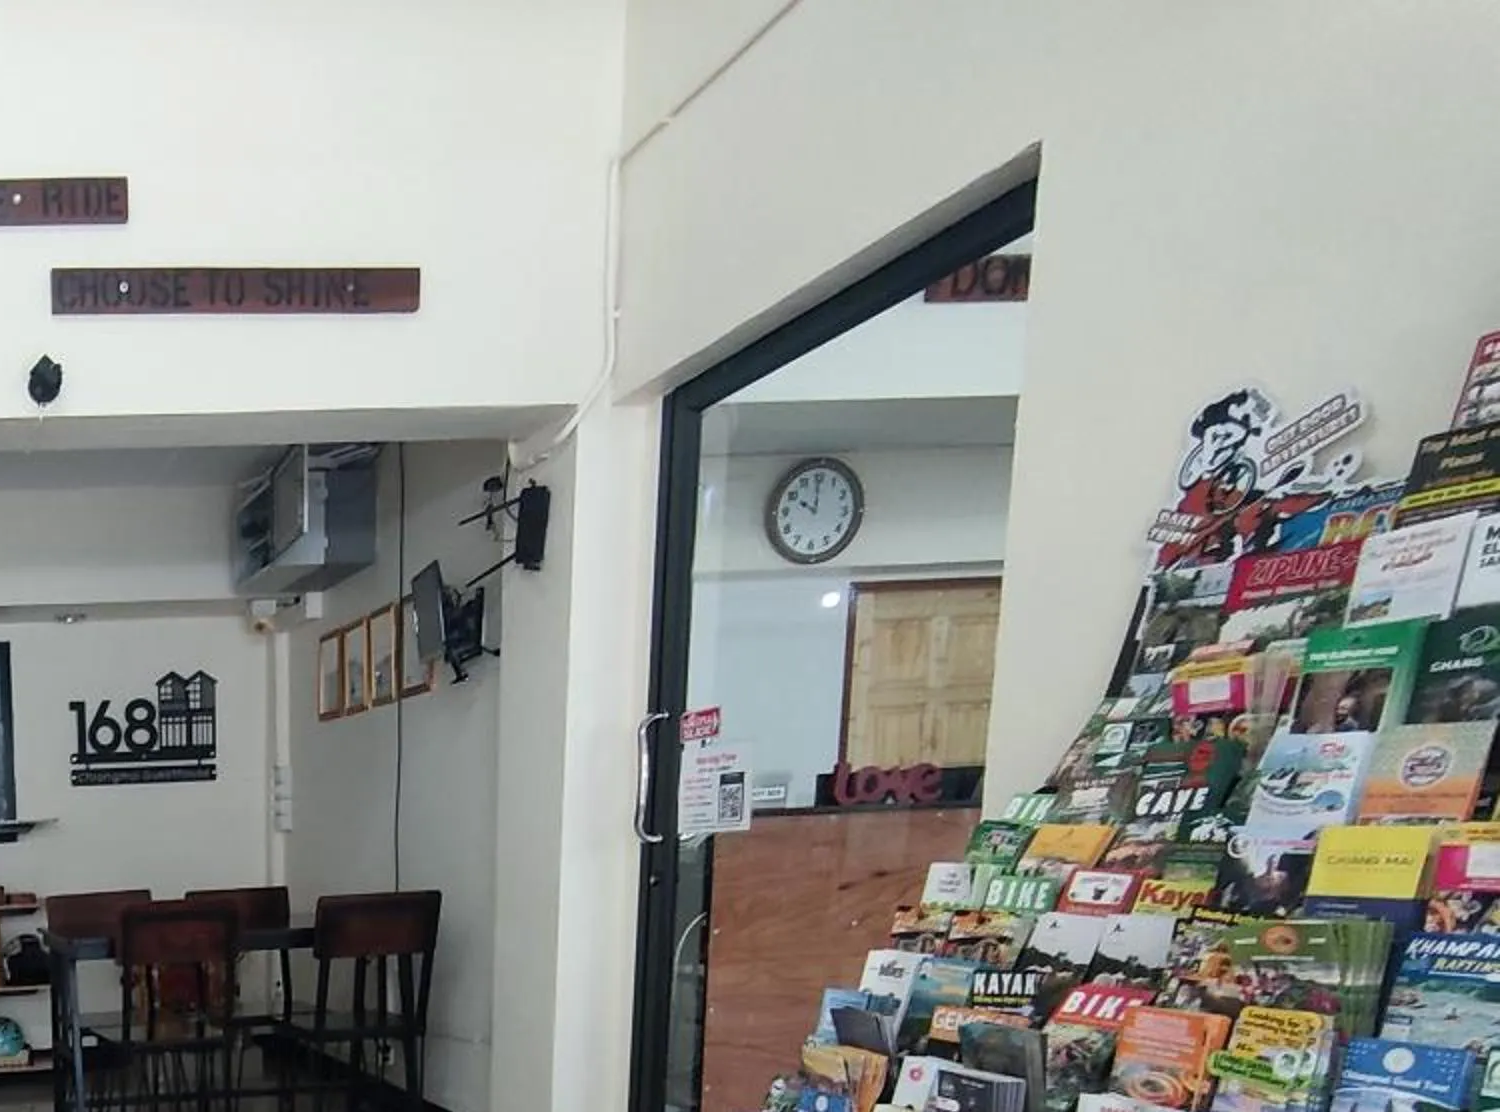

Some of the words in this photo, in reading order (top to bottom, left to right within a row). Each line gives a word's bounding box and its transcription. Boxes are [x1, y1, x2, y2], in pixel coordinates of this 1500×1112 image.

[40, 179, 125, 217] RIDE
[57, 270, 192, 308] CHOOSE
[201, 270, 246, 307] TO
[263, 271, 370, 308] SHINE
[69, 698, 158, 755] 168
[1135, 787, 1209, 816] CAVE
[985, 879, 1052, 909] BIKE
[973, 972, 1037, 996] KAYAK
